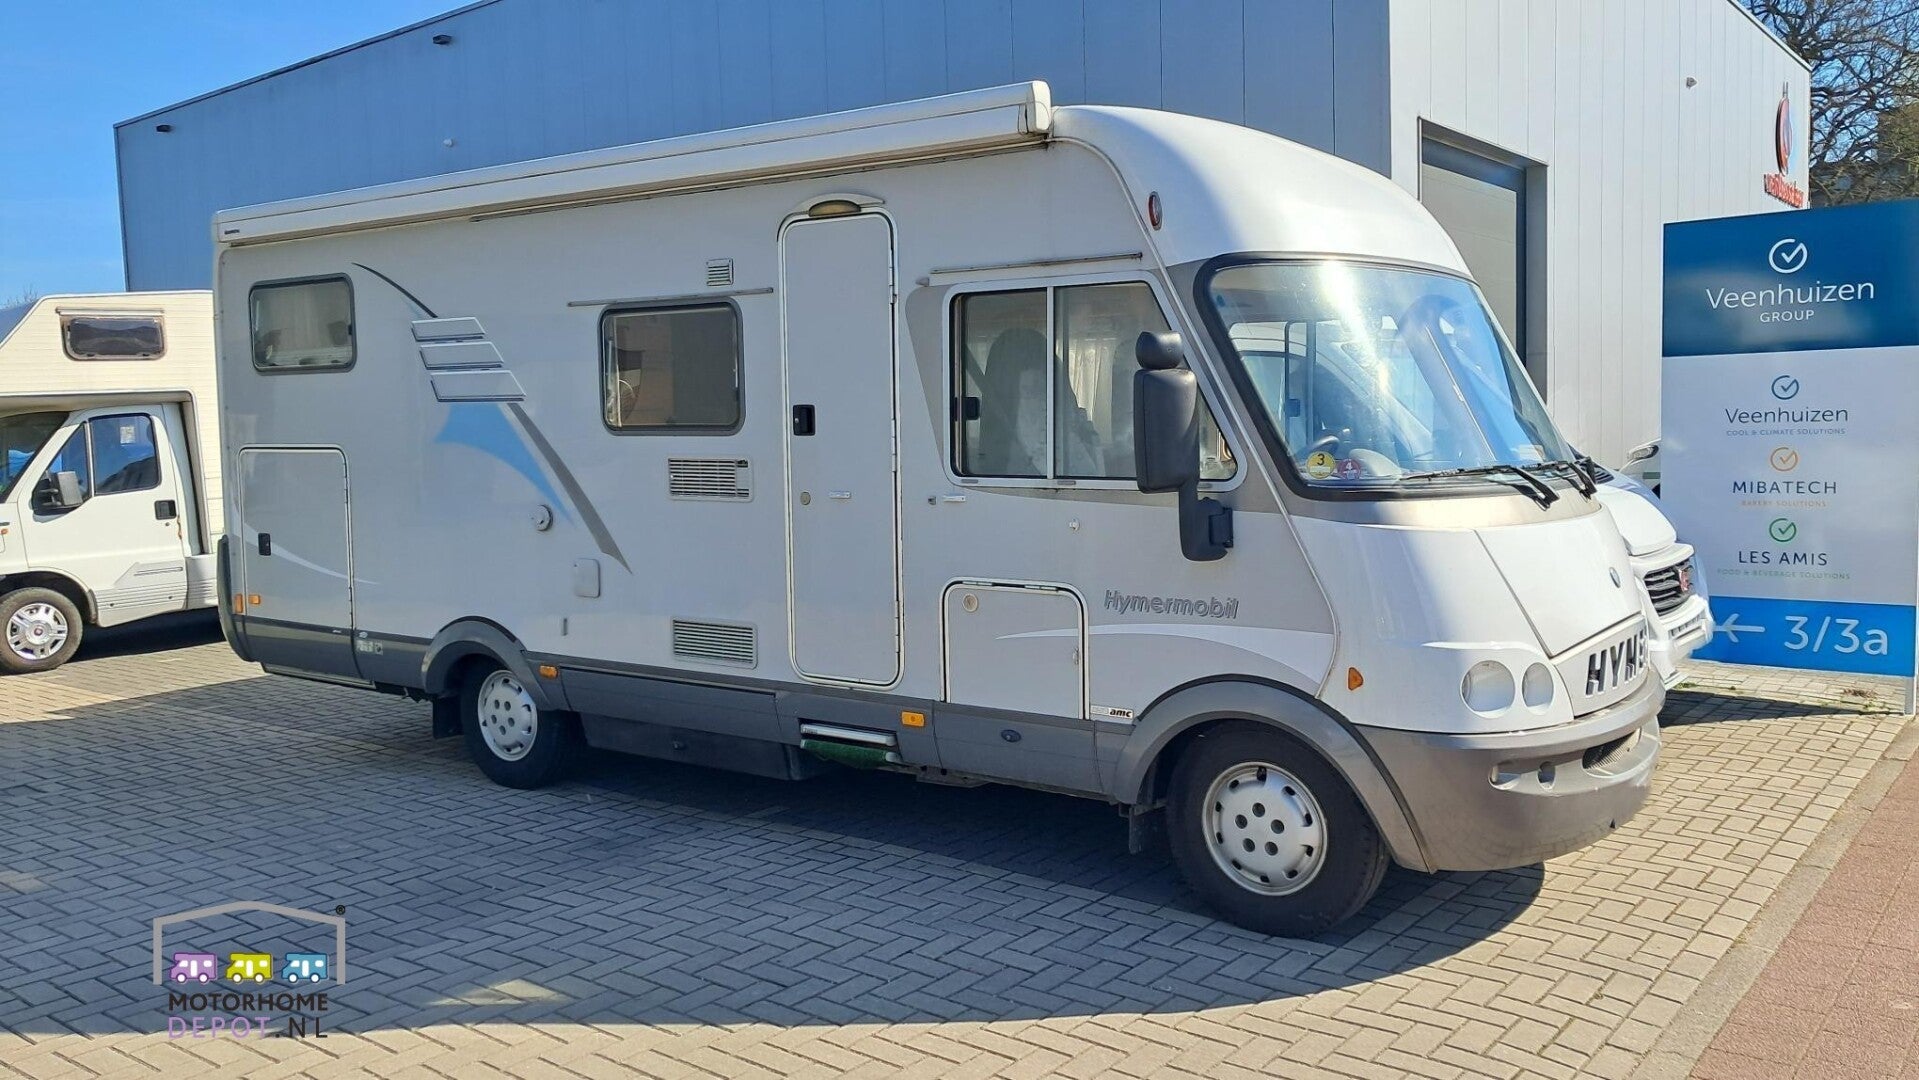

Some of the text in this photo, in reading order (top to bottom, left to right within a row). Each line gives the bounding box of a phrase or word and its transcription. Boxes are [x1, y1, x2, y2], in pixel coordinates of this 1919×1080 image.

[1705, 281, 1875, 309] Veenhuizen
[1760, 310, 1815, 323] GROUP
[1725, 406, 1848, 423] Veenhuizen
[1726, 429, 1749, 437] COOL
[1796, 427, 1846, 435] SOLUTIONS
[1316, 453, 1325, 466] 3
[1732, 480, 1837, 495] MIBATECH
[1776, 500, 1827, 508] SOLUTIONS
[1738, 551, 1828, 566] LES AMIS
[1799, 571, 1851, 580] SOLUTIONS
[1104, 589, 1240, 619] Hymermobil
[1784, 615, 1888, 655] 3/3a
[1109, 708, 1132, 718] amc
